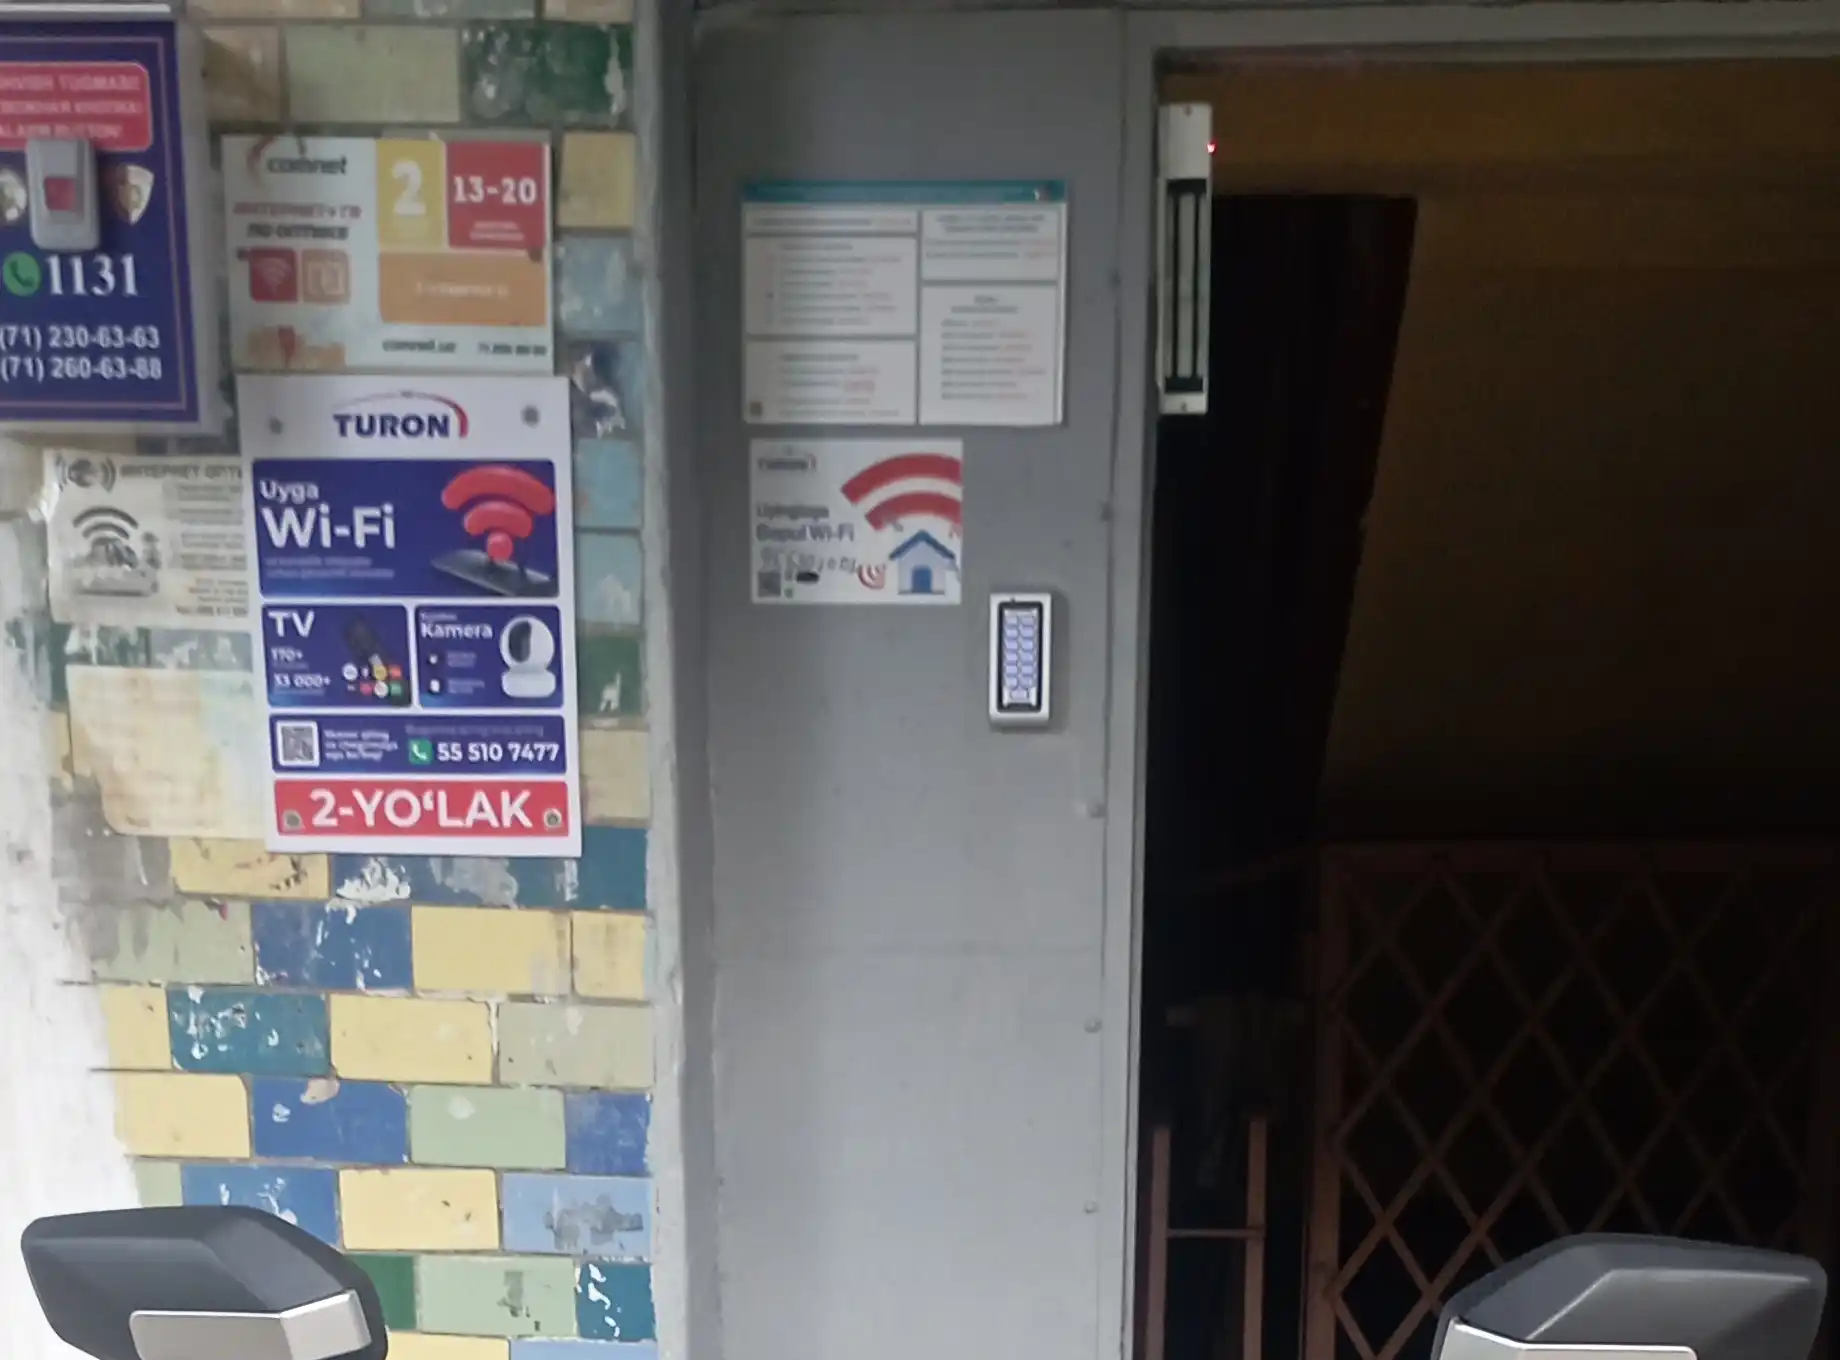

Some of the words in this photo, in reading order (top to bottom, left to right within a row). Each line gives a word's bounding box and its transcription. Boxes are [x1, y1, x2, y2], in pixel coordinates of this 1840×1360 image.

[391, 160, 426, 215] 2
[453, 175, 537, 206] 13-20
[46, 253, 139, 297] 1131
[0, 324, 42, 351] (71)
[48, 324, 161, 350] 230-63-63
[1, 355, 45, 383] (71)
[50, 355, 164, 381] 260-63-88
[333, 413, 450, 438] TURON
[260, 479, 320, 504] Uyga
[260, 502, 396, 549] Wi-Fi
[267, 609, 316, 638] TV
[420, 623, 494, 640] Kamera
[437, 742, 463, 762] 55
[468, 742, 503, 762] 510
[511, 742, 560, 763] 7477
